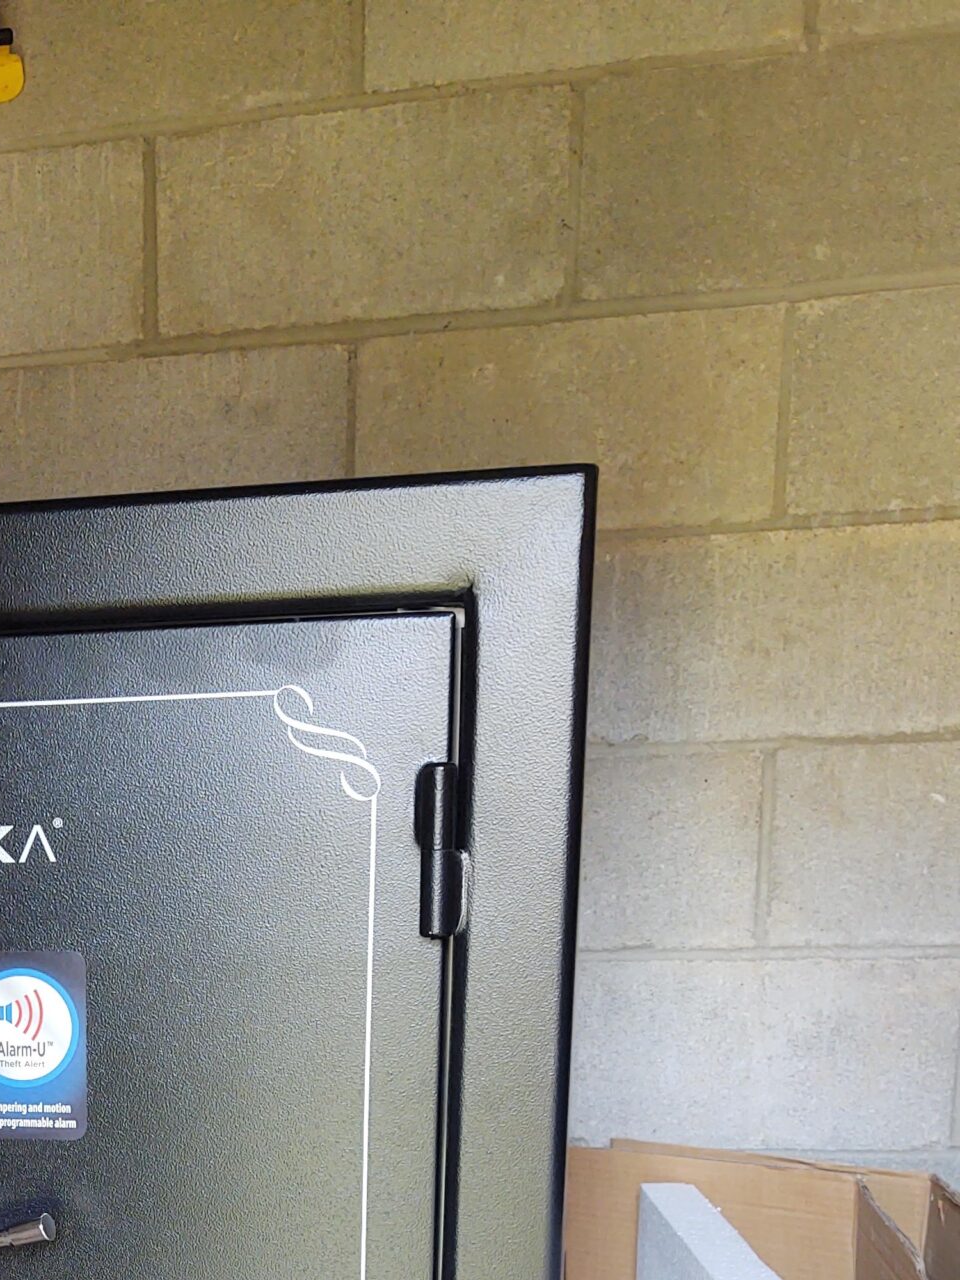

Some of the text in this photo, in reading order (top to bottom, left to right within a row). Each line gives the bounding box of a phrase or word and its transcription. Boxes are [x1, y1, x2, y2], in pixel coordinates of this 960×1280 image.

[0, 1060, 45, 1068] Theft Alert
[28, 1102, 43, 1113] and
[43, 1102, 71, 1114] motion
[0, 1116, 53, 1129] programmable
[54, 1117, 77, 1129] alarm
